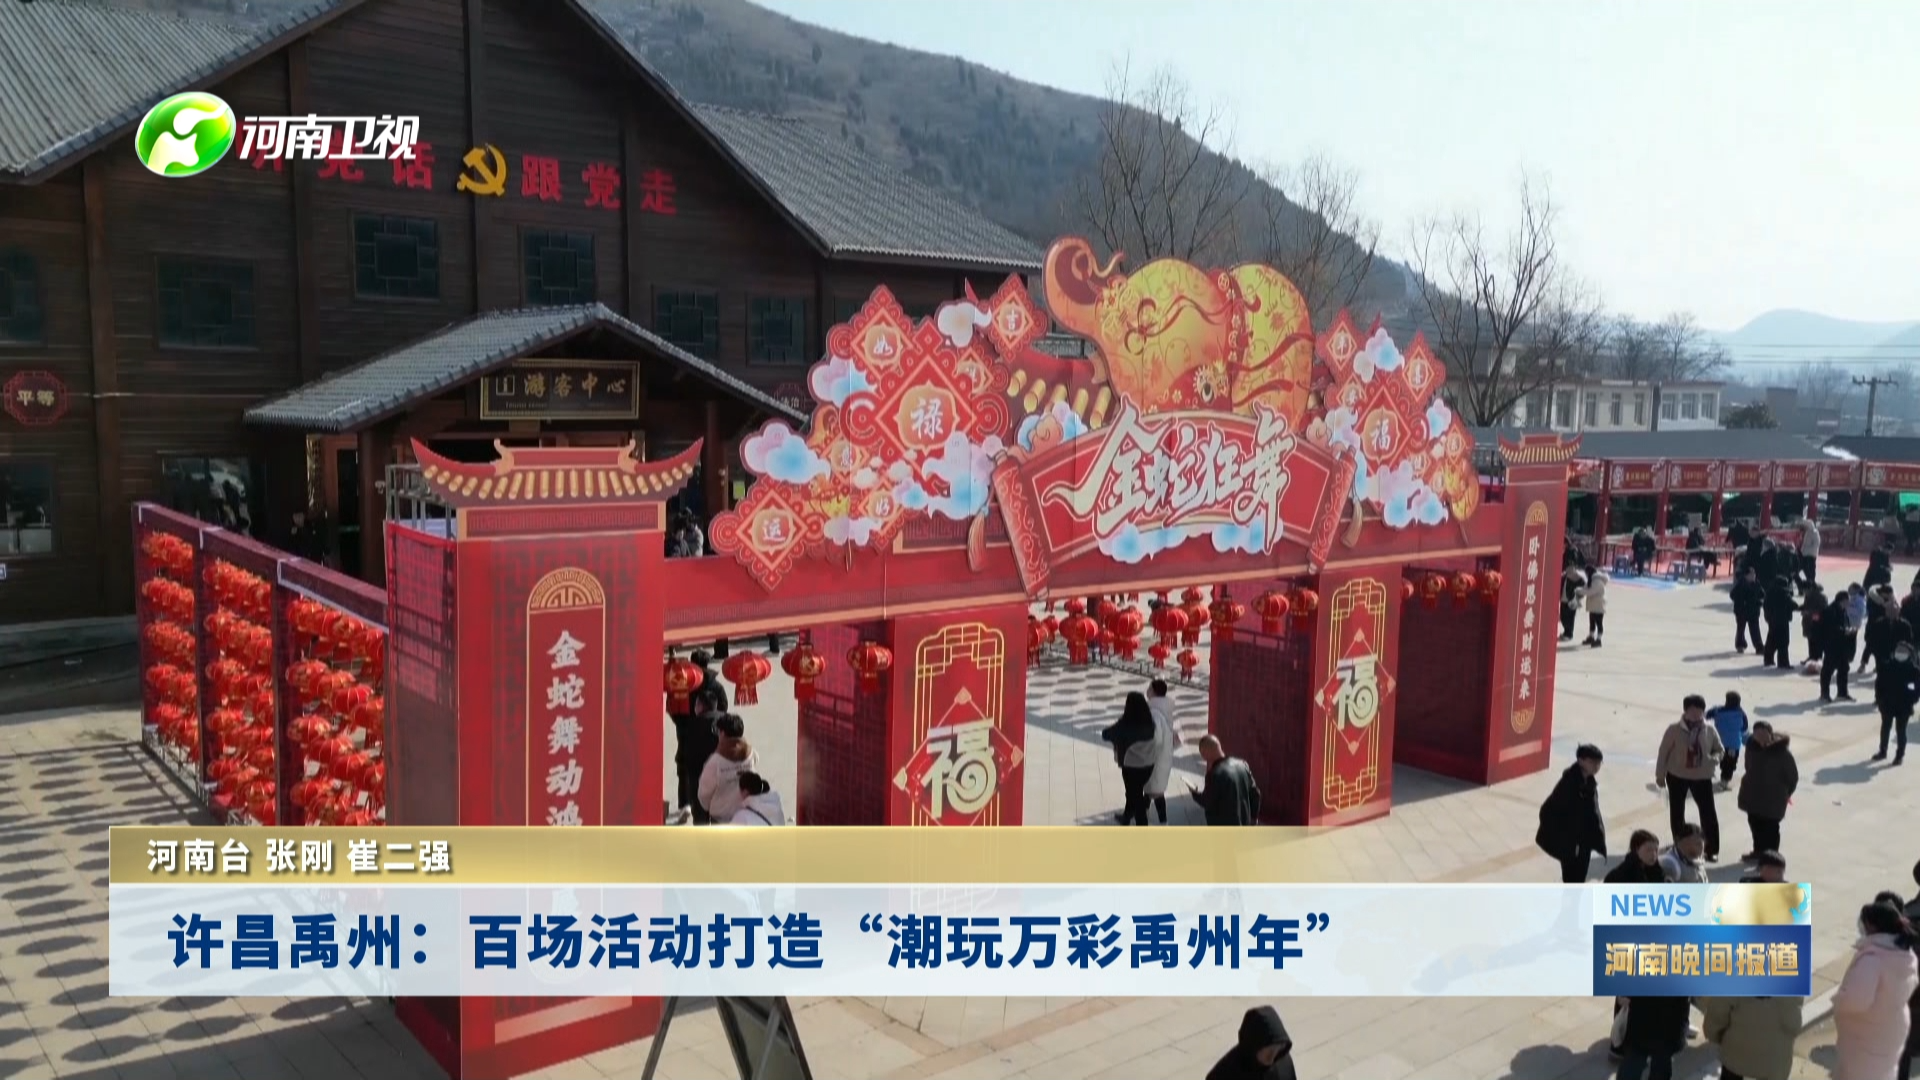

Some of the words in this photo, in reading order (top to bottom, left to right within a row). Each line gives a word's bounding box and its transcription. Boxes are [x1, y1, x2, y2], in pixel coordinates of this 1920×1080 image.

[521, 153, 678, 216] 跟党走
[523, 371, 627, 400] 游客中心
[910, 397, 944, 440] 禄
[1369, 417, 1392, 452] 福
[1042, 395, 1296, 555] 金蛇狂舞
[1332, 654, 1379, 730] 福
[920, 717, 998, 819] 福
